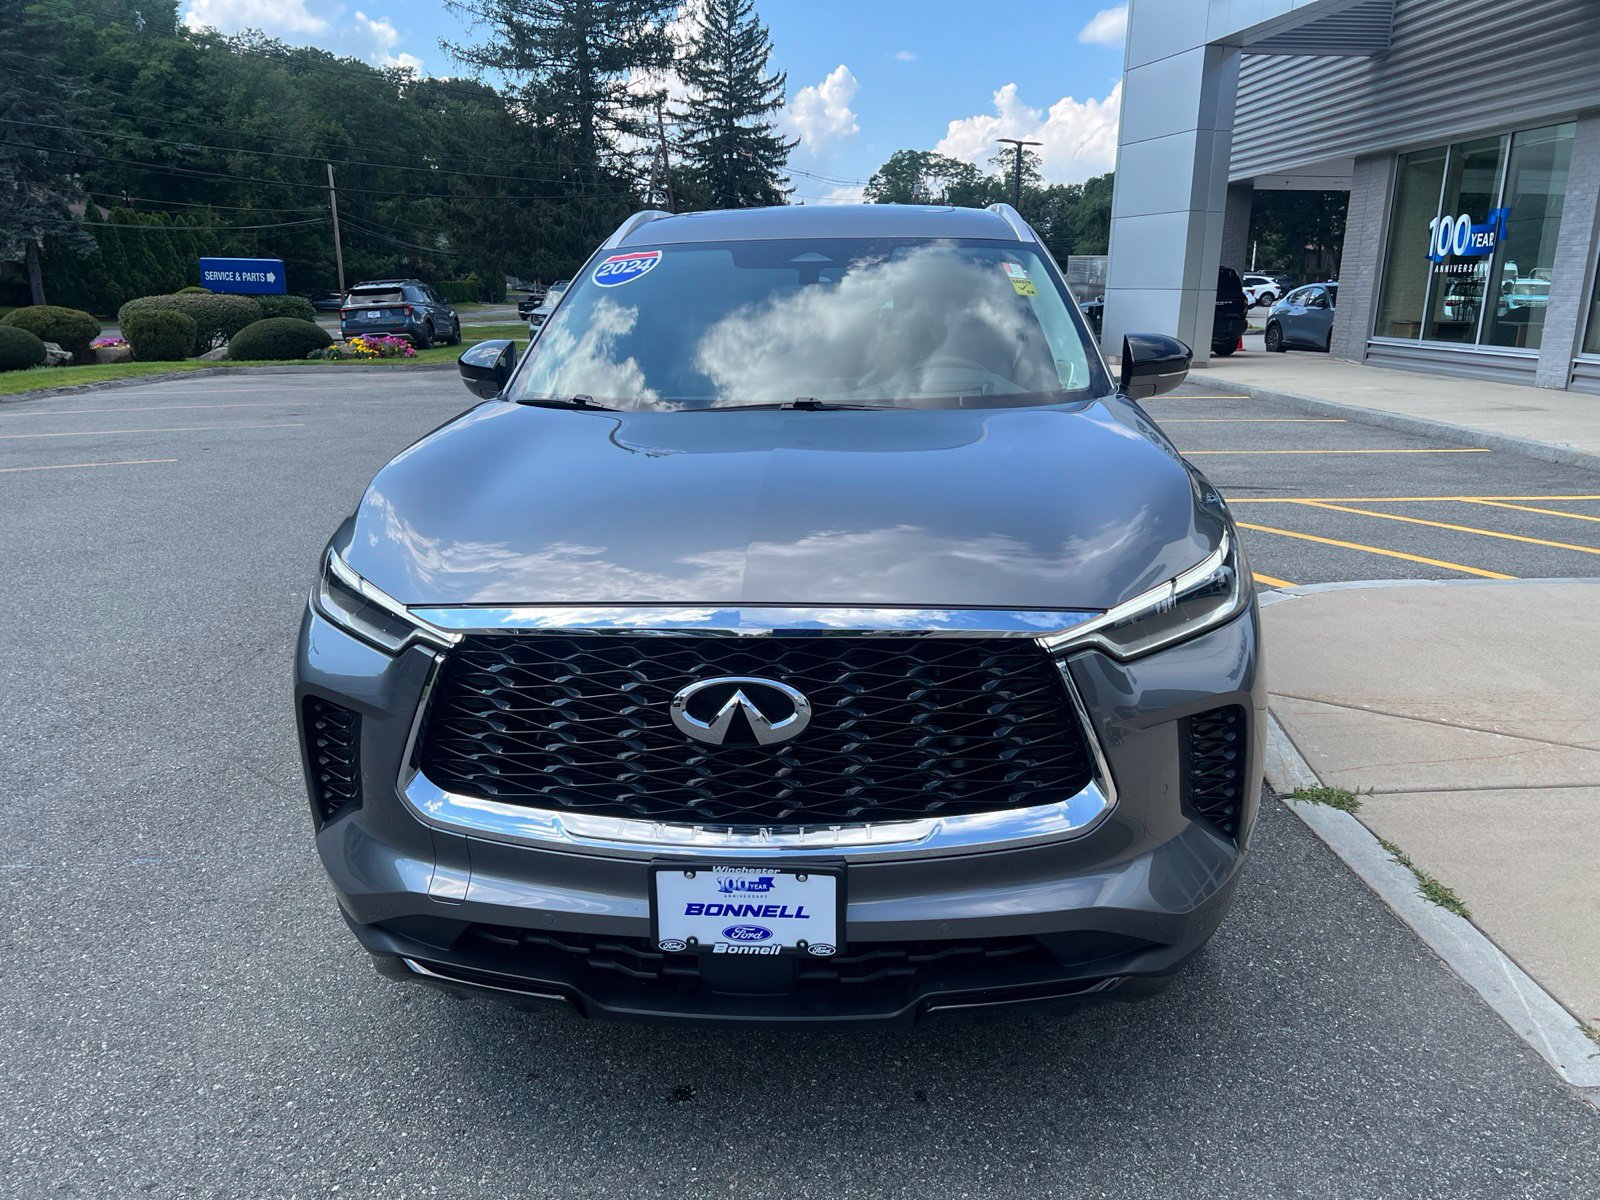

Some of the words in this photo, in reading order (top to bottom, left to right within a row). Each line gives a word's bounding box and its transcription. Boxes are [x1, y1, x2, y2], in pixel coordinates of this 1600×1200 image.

[1428, 213, 1472, 257] 100
[1470, 231, 1495, 248] YEAR
[596, 258, 654, 277] 2024
[204, 270, 234, 281] SERVICE
[235, 271, 241, 281] &
[242, 272, 266, 282] PARTS
[617, 821, 873, 843] INFINITI
[712, 865, 781, 875] Winchester
[717, 876, 750, 893] 100
[749, 882, 768, 891] YEAR
[684, 902, 811, 919] BONNELL
[731, 926, 766, 941] Ford
[662, 941, 684, 950] Ford
[712, 941, 783, 956] Bonnell
